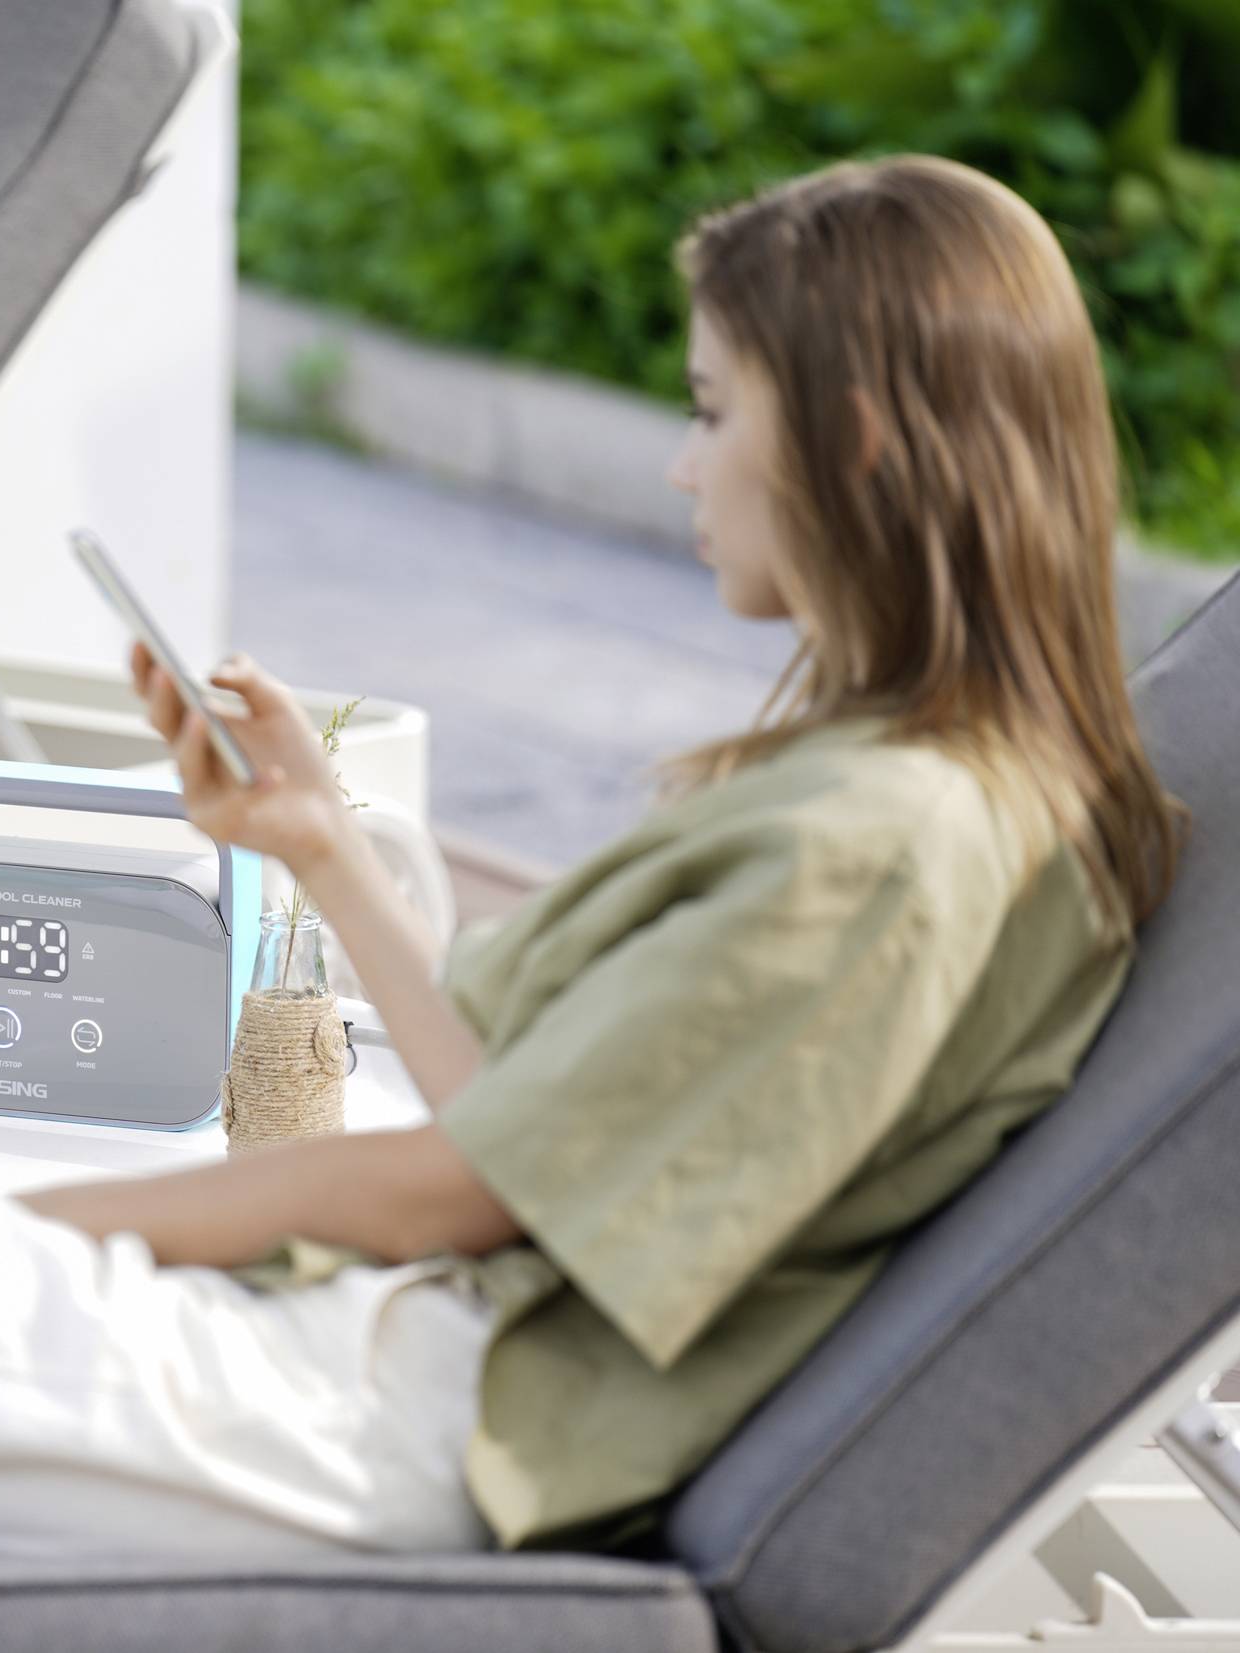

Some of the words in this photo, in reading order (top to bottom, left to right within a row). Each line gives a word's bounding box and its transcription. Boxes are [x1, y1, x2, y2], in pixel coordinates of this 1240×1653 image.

[22, 894, 82, 908] CLEANER
[7, 988, 32, 996] CUSTOM
[76, 1061, 96, 1069] MODE
